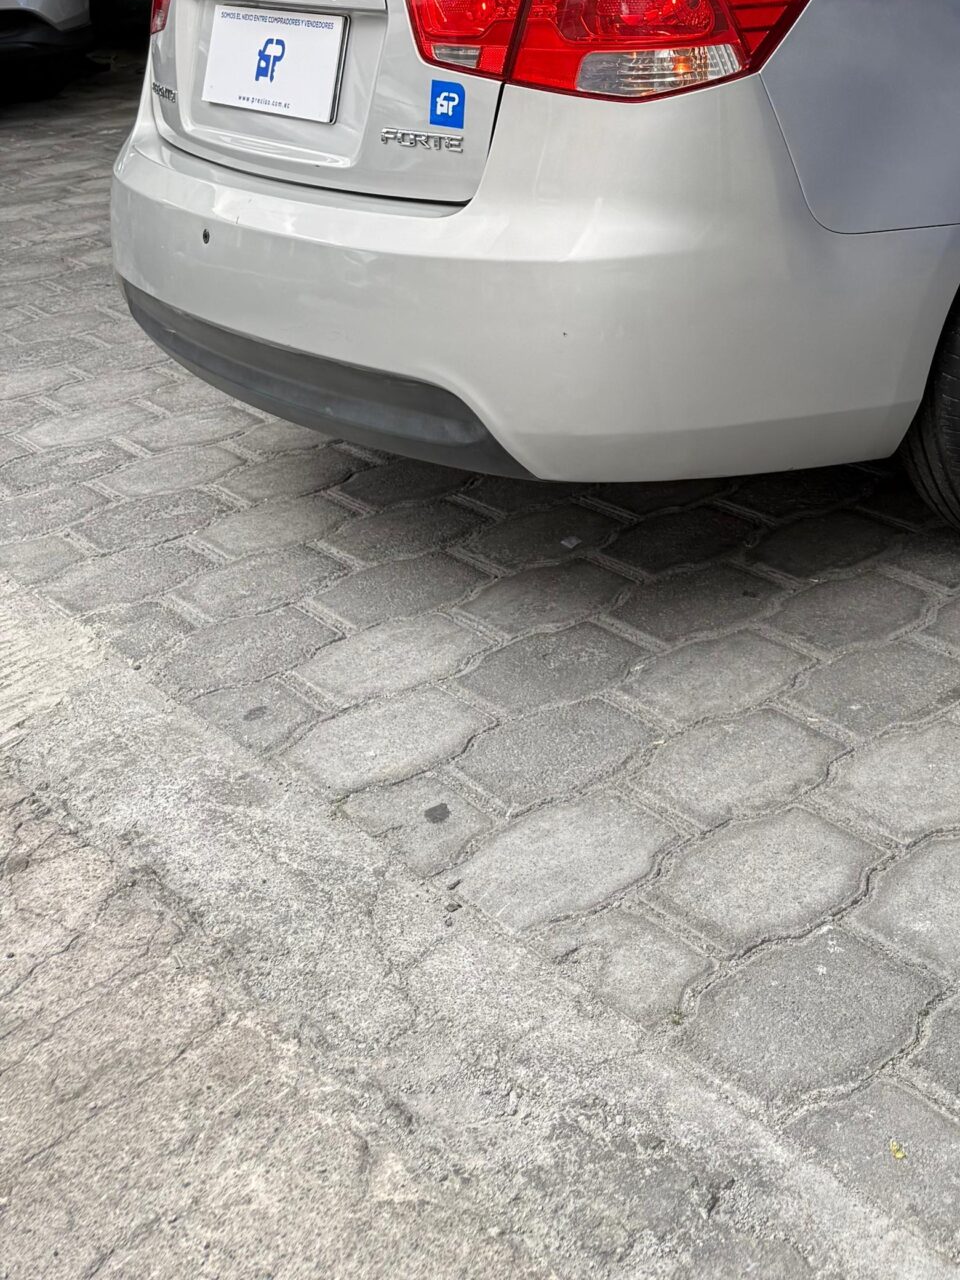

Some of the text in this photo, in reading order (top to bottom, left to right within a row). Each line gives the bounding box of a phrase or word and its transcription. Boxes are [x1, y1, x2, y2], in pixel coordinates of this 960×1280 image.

[268, 16, 301, 26] COMPRADORES
[304, 20, 335, 30] VENDEDORES
[380, 127, 464, 153] FORTE
